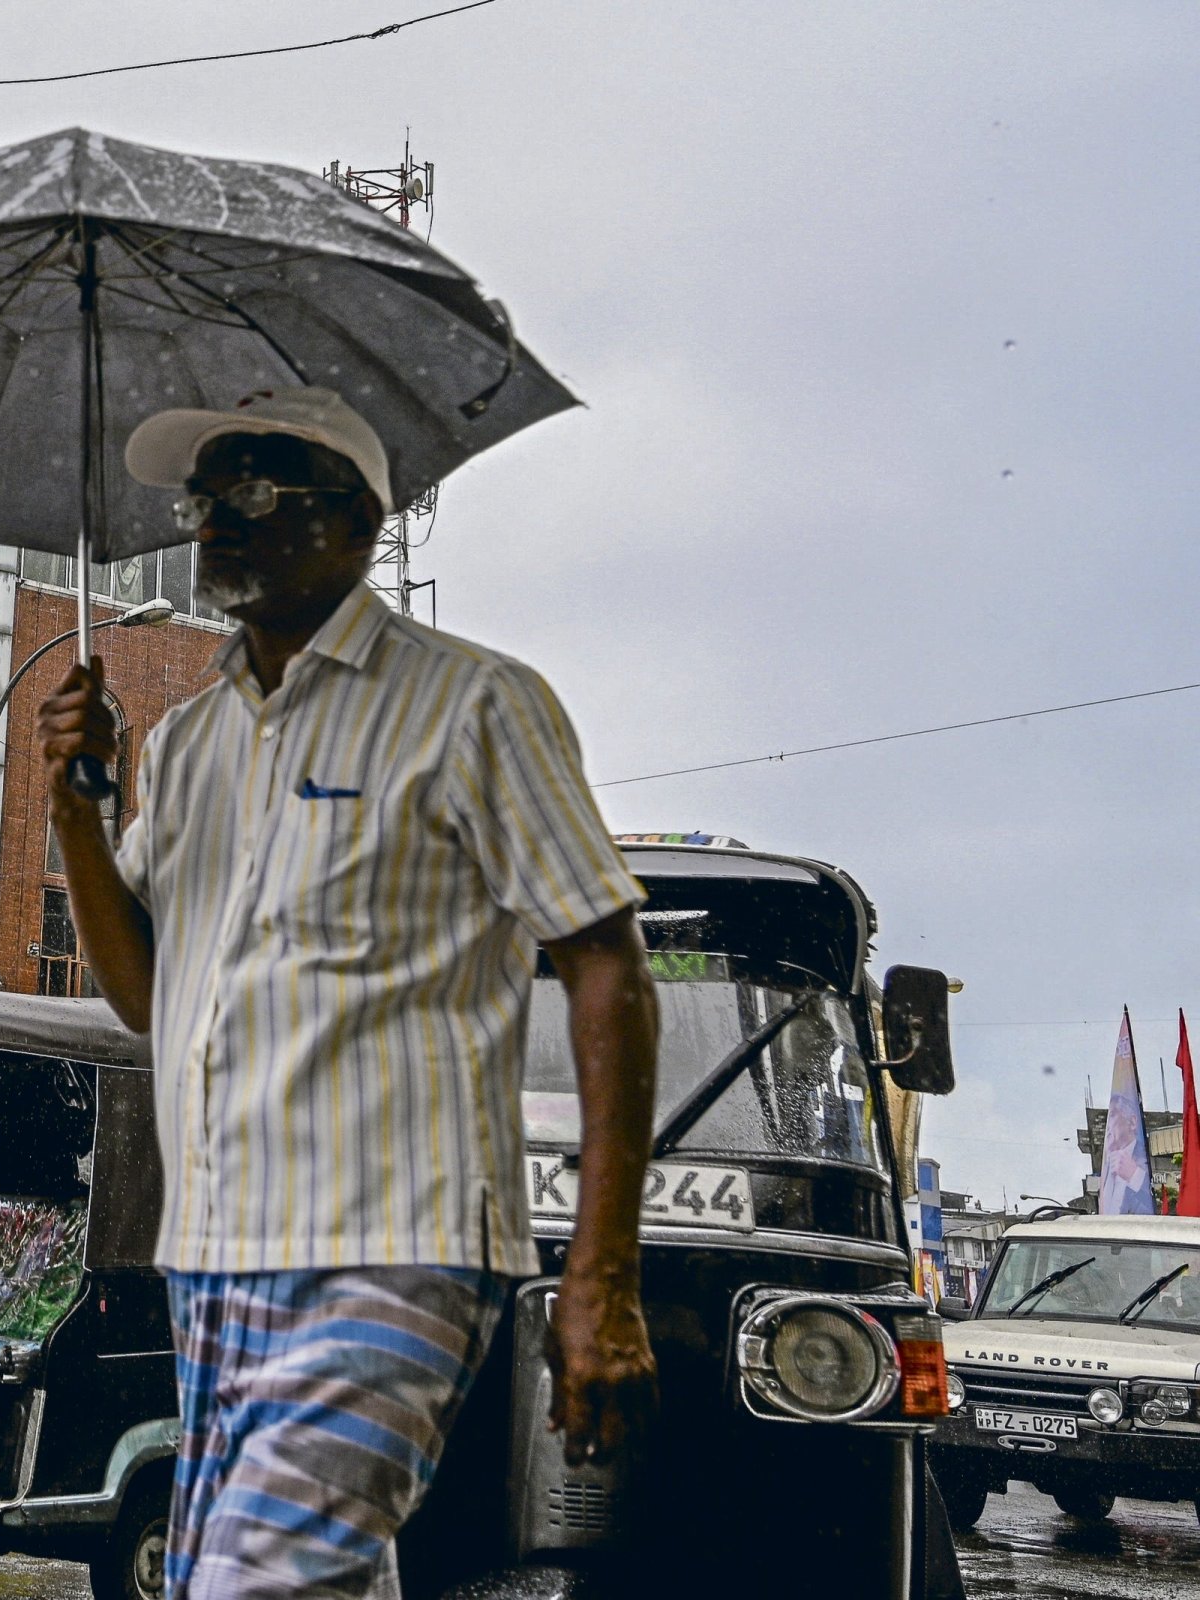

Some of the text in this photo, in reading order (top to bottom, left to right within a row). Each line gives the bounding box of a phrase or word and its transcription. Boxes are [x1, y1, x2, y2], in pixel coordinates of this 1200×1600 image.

[648, 953, 707, 980] AXI
[964, 1350, 1110, 1371] LAND ROVER
